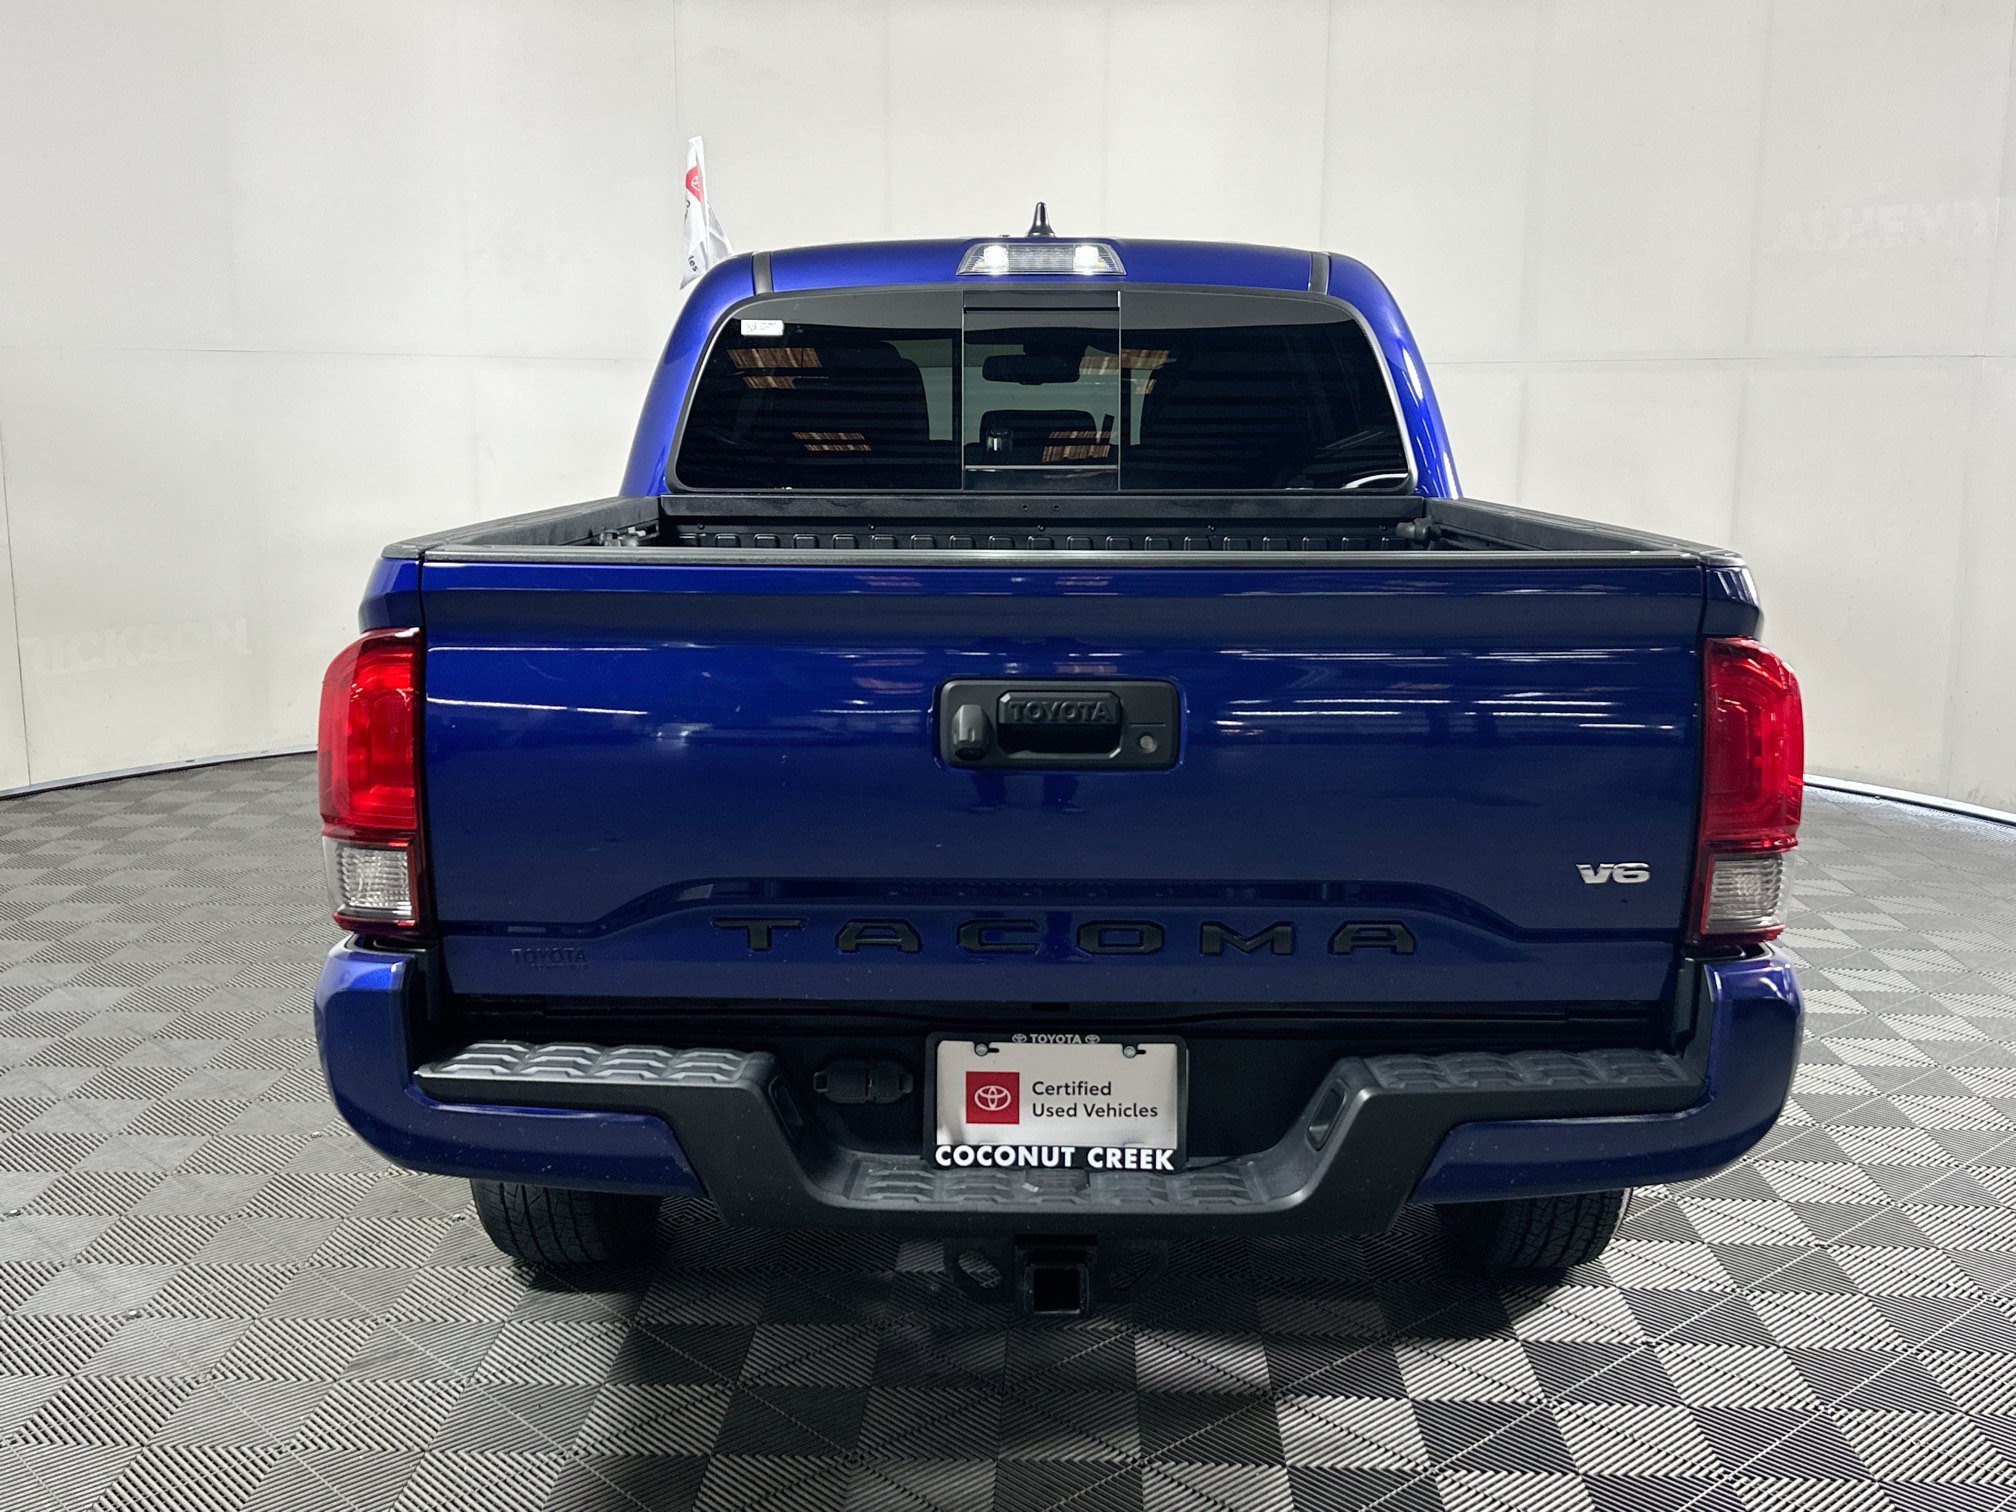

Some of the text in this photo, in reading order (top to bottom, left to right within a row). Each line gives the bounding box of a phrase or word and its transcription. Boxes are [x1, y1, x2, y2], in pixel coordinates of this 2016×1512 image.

[1009, 700, 1112, 722] TOYOTA
[1576, 862, 1650, 884] V6
[710, 916, 1418, 956] TACOMA
[1029, 1033, 1083, 1044] TOYOTA
[1032, 1080, 1112, 1096] Certified
[1032, 1102, 1158, 1118] Used Vehicles
[934, 1144, 1175, 1171] COCONUT CREEK
